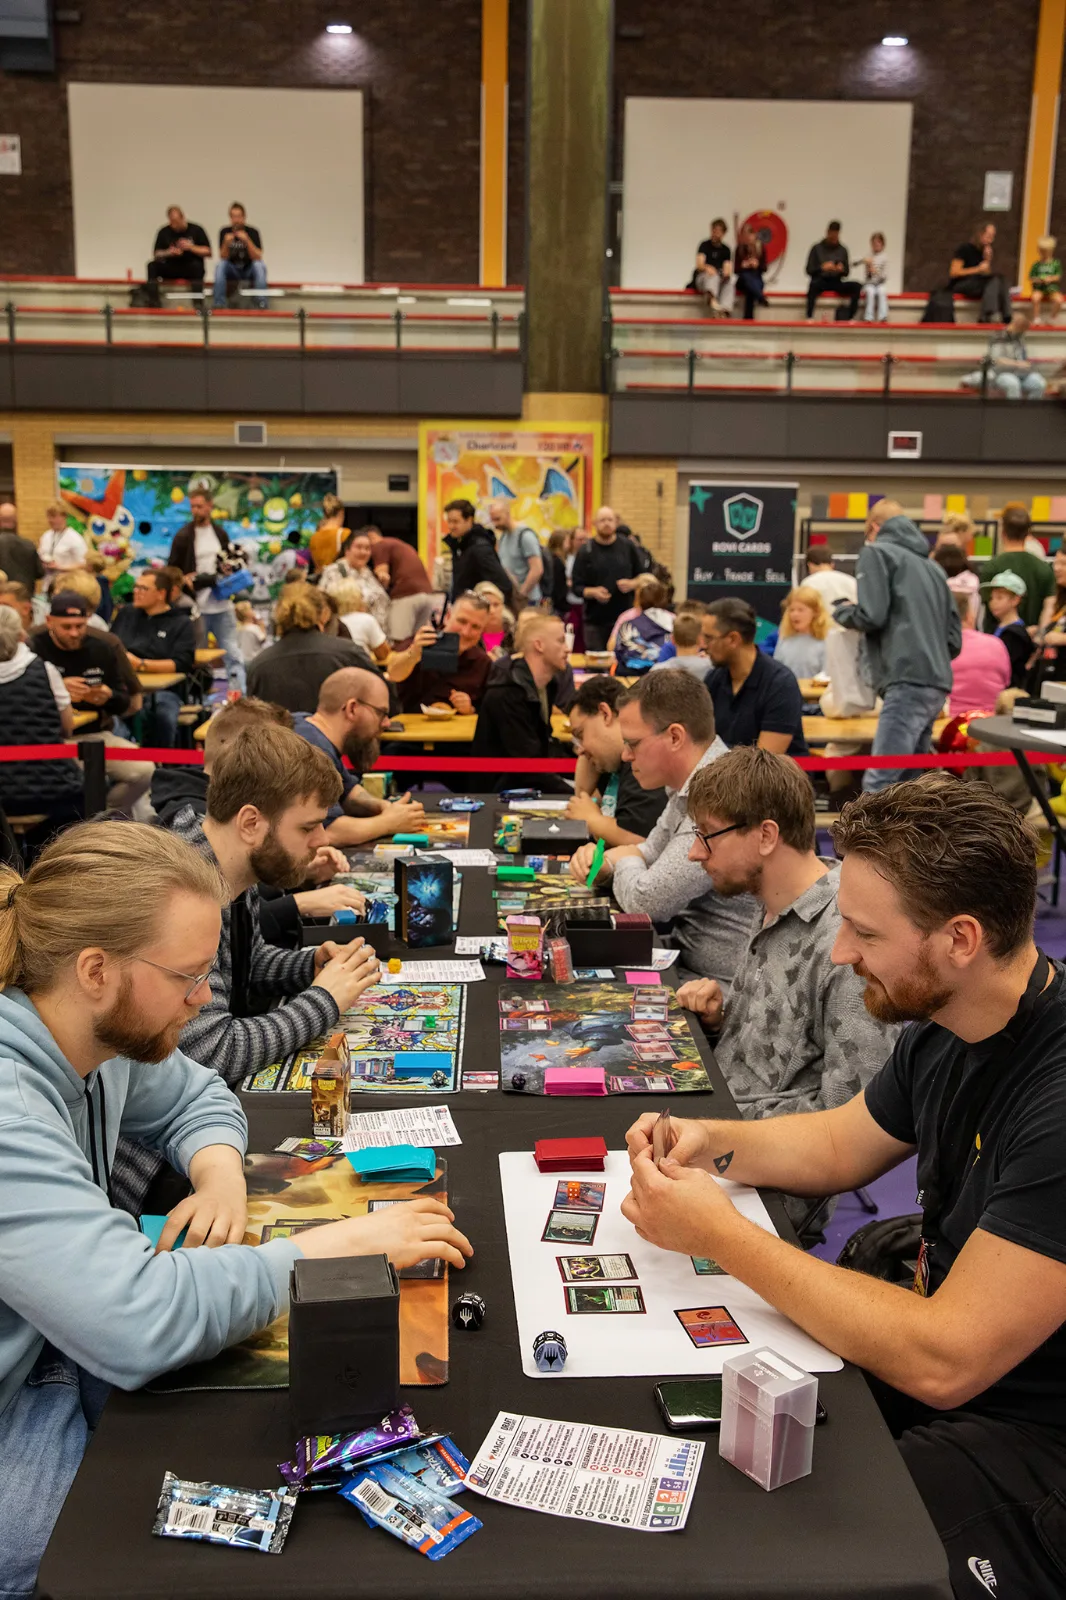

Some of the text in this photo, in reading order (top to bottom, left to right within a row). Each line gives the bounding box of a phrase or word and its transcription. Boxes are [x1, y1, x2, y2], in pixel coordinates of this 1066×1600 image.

[712, 542, 772, 554] ROVI CARDS
[501, 1418, 513, 1430] DRAFT
[492, 1435, 505, 1456] MAGIC
[422, 1448, 462, 1487] AVATAR
[440, 1449, 464, 1477] PLAY BOOSTER
[475, 1463, 488, 1476] TCG
[978, 1560, 996, 1587] NIKE
